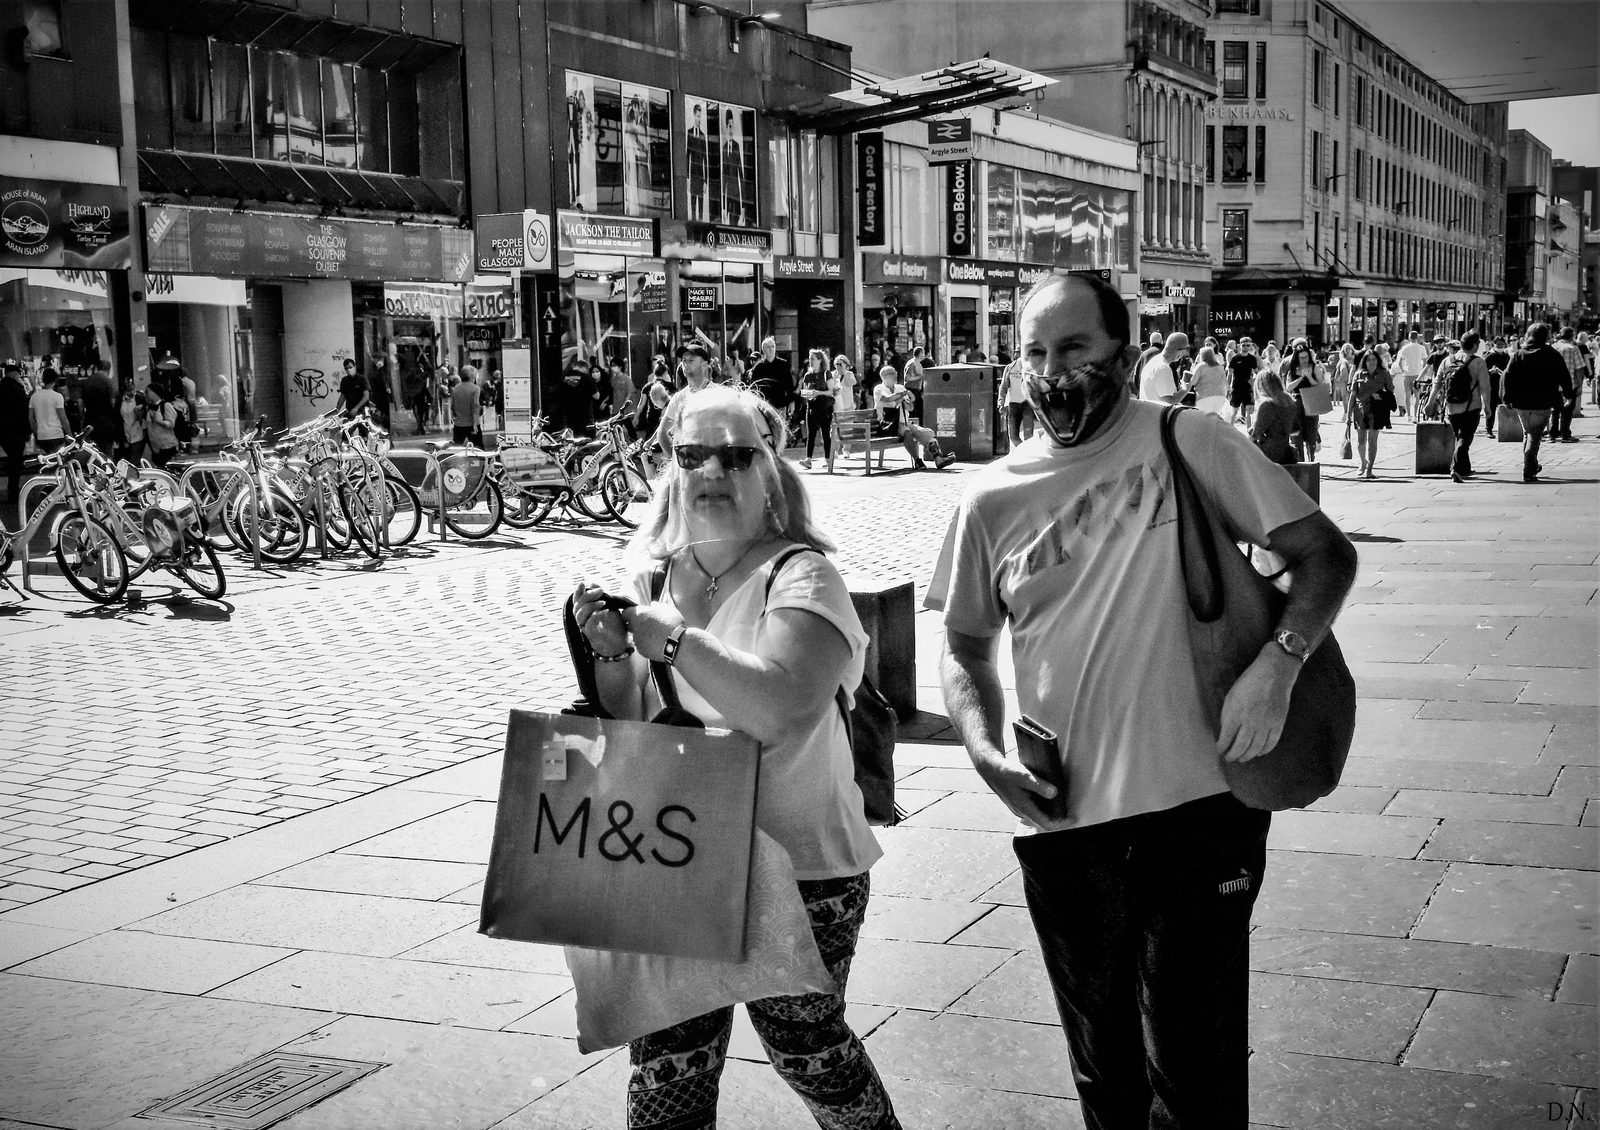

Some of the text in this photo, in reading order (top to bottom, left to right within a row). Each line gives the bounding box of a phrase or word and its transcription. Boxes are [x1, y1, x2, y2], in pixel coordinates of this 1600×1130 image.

[931, 146, 968, 157] Argyle Street
[1, 189, 22, 202] HOUSE
[29, 192, 47, 205] ARAN
[864, 145, 877, 233] Card Factory
[68, 203, 111, 220] HIGHLAND
[148, 210, 171, 244] SALE
[319, 224, 333, 235] THE
[565, 223, 651, 240] JACKSON THE TAILOR
[5, 240, 49, 256] ARAN ISLANDS
[306, 234, 348, 248] GLASGOW
[491, 238, 523, 248] PEOPLE
[719, 232, 767, 248] BENNY HAMISH
[308, 249, 347, 261] SOUVENIR
[498, 247, 523, 257] MAKE
[315, 262, 340, 272] OUTLET
[455, 252, 471, 279] SALE
[480, 257, 523, 268] GLASGOW
[780, 259, 814, 275] Argyle Street
[883, 261, 928, 281] Card Factory
[533, 792, 697, 868] M&S
